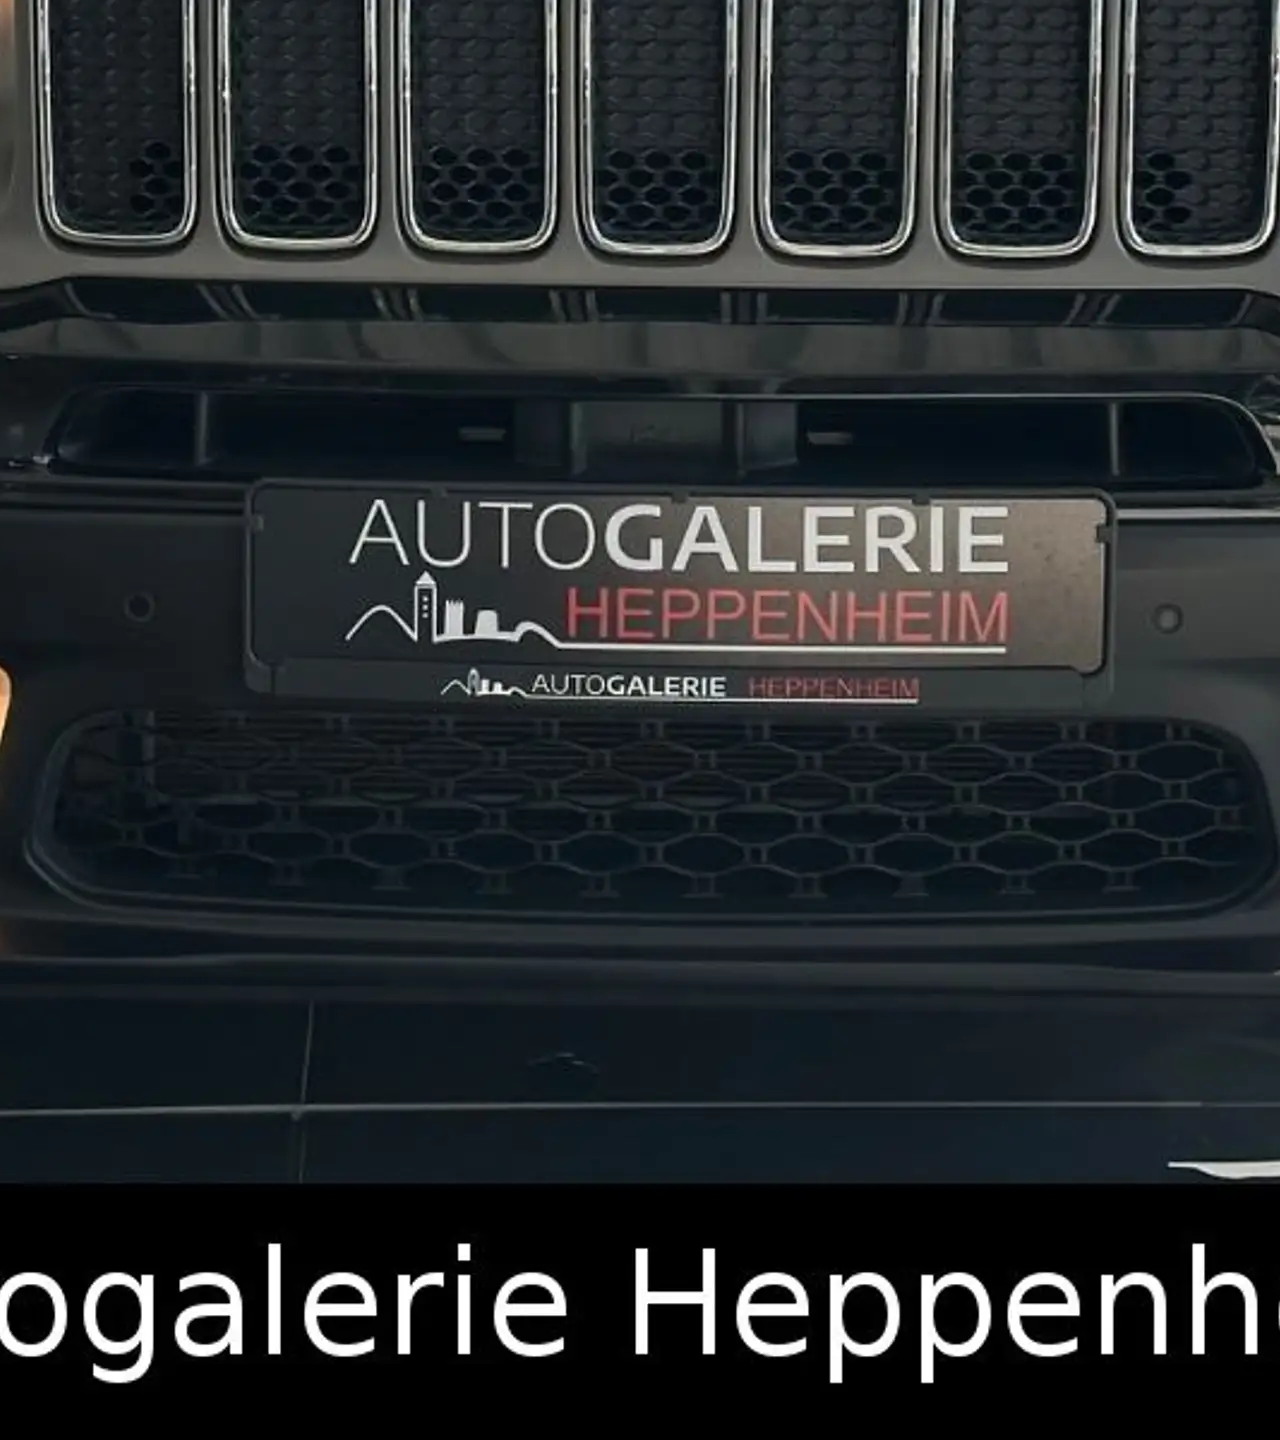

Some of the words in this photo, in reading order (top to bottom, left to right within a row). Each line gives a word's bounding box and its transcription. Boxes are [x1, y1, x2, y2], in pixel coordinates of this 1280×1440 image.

[349, 497, 1010, 573] AUTOGALERIE
[565, 586, 1010, 643] HEPPENHEIM
[531, 673, 727, 697] AUTOGALERIE
[747, 676, 920, 698] HEPPENHEIM
